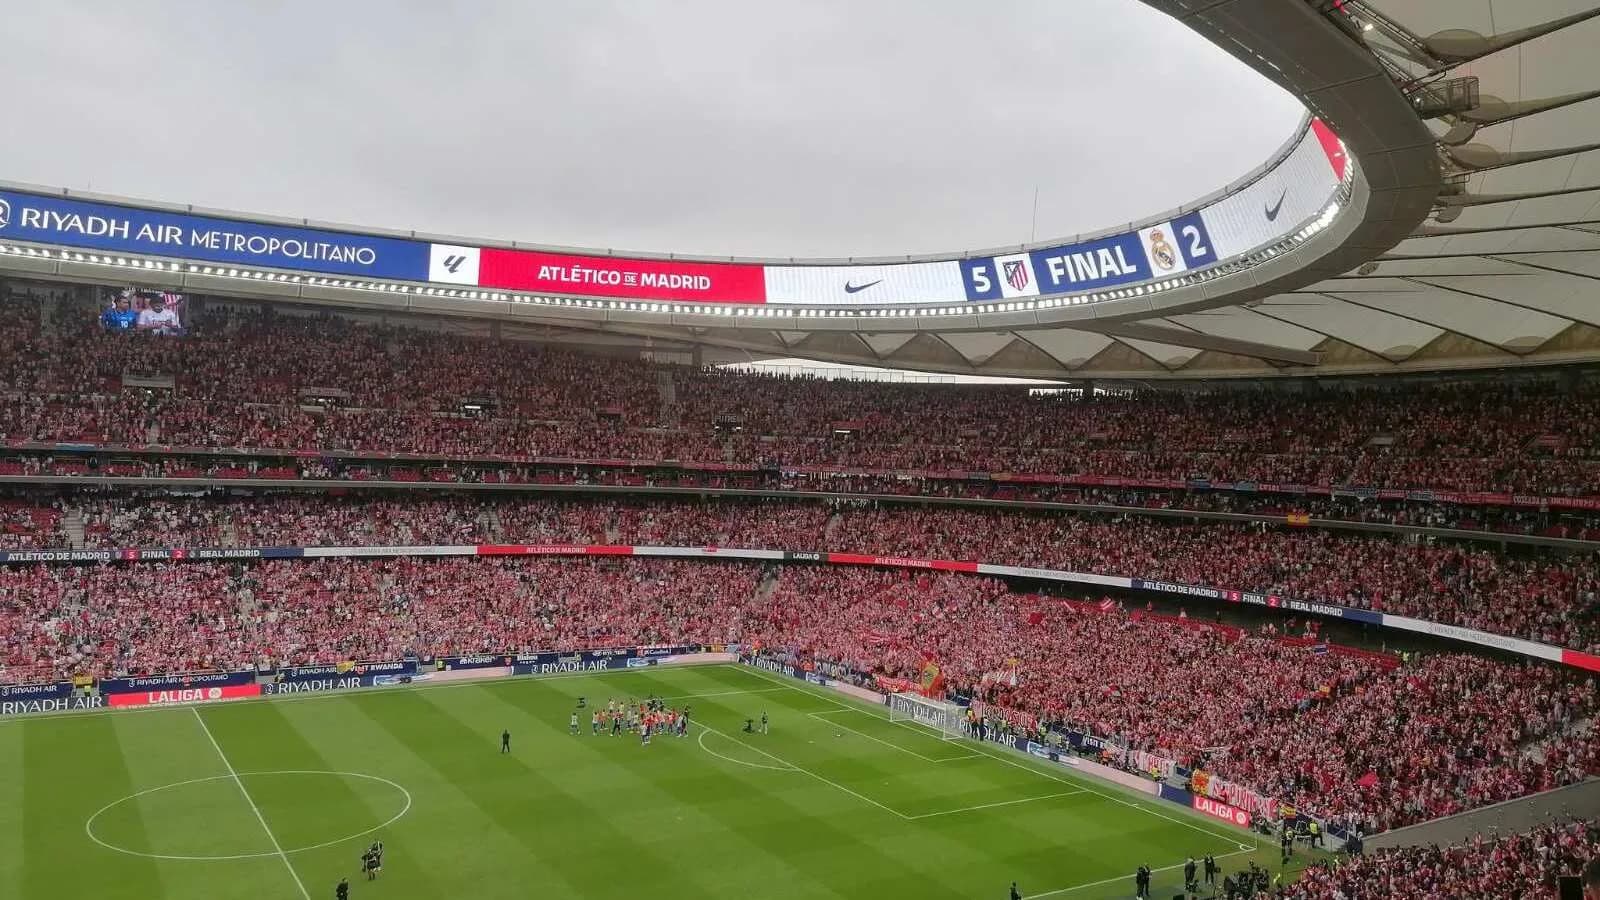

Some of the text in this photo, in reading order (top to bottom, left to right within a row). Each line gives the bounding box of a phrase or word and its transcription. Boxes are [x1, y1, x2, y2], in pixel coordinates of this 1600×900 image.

[20, 207, 375, 265] RIYADH AIR METROPOLITANO
[971, 225, 1207, 293] 5 FINAL 2
[537, 264, 711, 290] ATLÉTICO DE MADRID
[7, 549, 260, 561] ATLÉTICO DE MADRID 5 FINAL 2 REAL MADRID
[908, 560, 932, 568] MADRID
[1143, 580, 1343, 617] ATLÉTICO DE MADRID 5 FINAL 2 REAL MADRID
[300, 667, 324, 675] RIYADH
[370, 662, 403, 671] RWANDA
[541, 660, 608, 674] RIYADH AIR
[756, 657, 795, 677] RIYADH AIR
[11, 685, 57, 695] RIYADH AIR
[137, 677, 164, 687] RIYADH
[166, 676, 178, 685] AIR
[279, 677, 361, 695] RIYADH AIR
[2, 695, 103, 714] RIYADH AIR
[148, 688, 203, 704] LALIGA
[897, 699, 930, 720] RIYADH
[998, 733, 1017, 748] AIR
[1195, 796, 1234, 820] LALIGA
